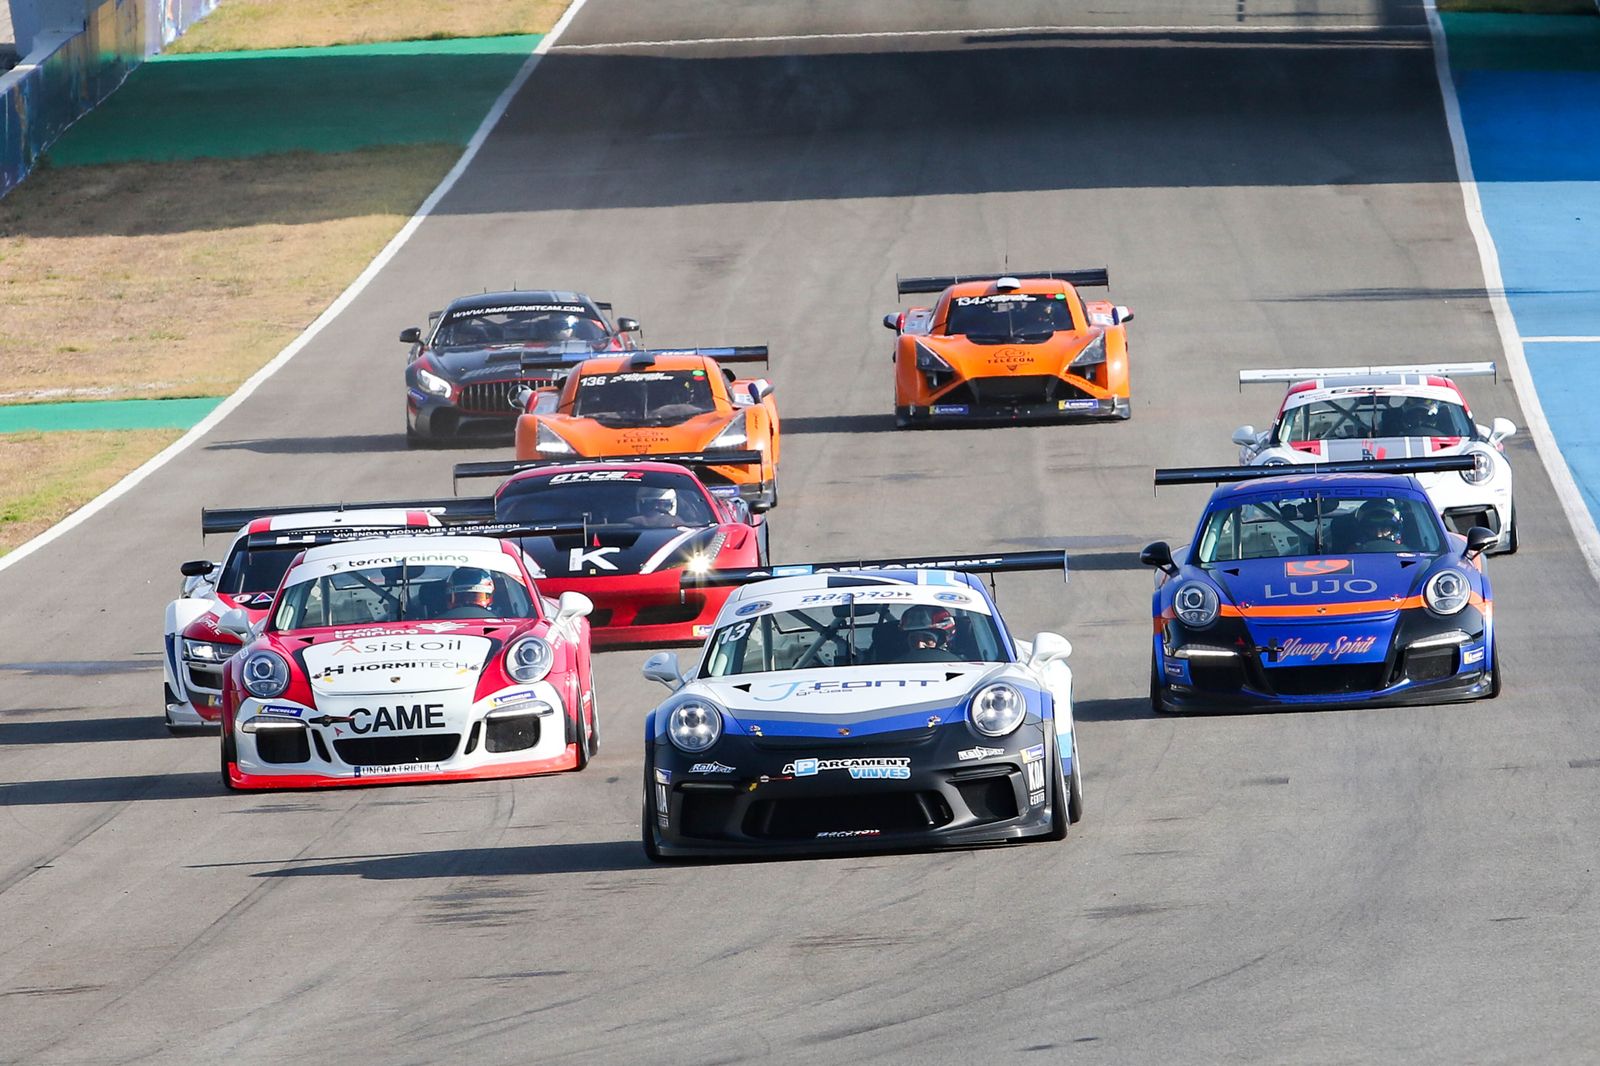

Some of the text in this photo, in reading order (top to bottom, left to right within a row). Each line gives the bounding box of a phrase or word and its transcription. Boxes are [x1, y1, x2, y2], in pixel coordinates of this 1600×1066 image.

[579, 375, 607, 387] 136
[333, 530, 384, 538] VIVIENDAS
[387, 526, 447, 536] MODULARES
[450, 525, 462, 533] DE
[464, 523, 521, 531] HORMIGON
[568, 546, 621, 572] K
[1264, 579, 1379, 599] LUJO
[720, 622, 751, 645] 13
[1277, 634, 1377, 663] Young Spirit
[351, 661, 469, 674] HORMITECH
[349, 703, 446, 735] CAME
[848, 766, 911, 780] VINYES
